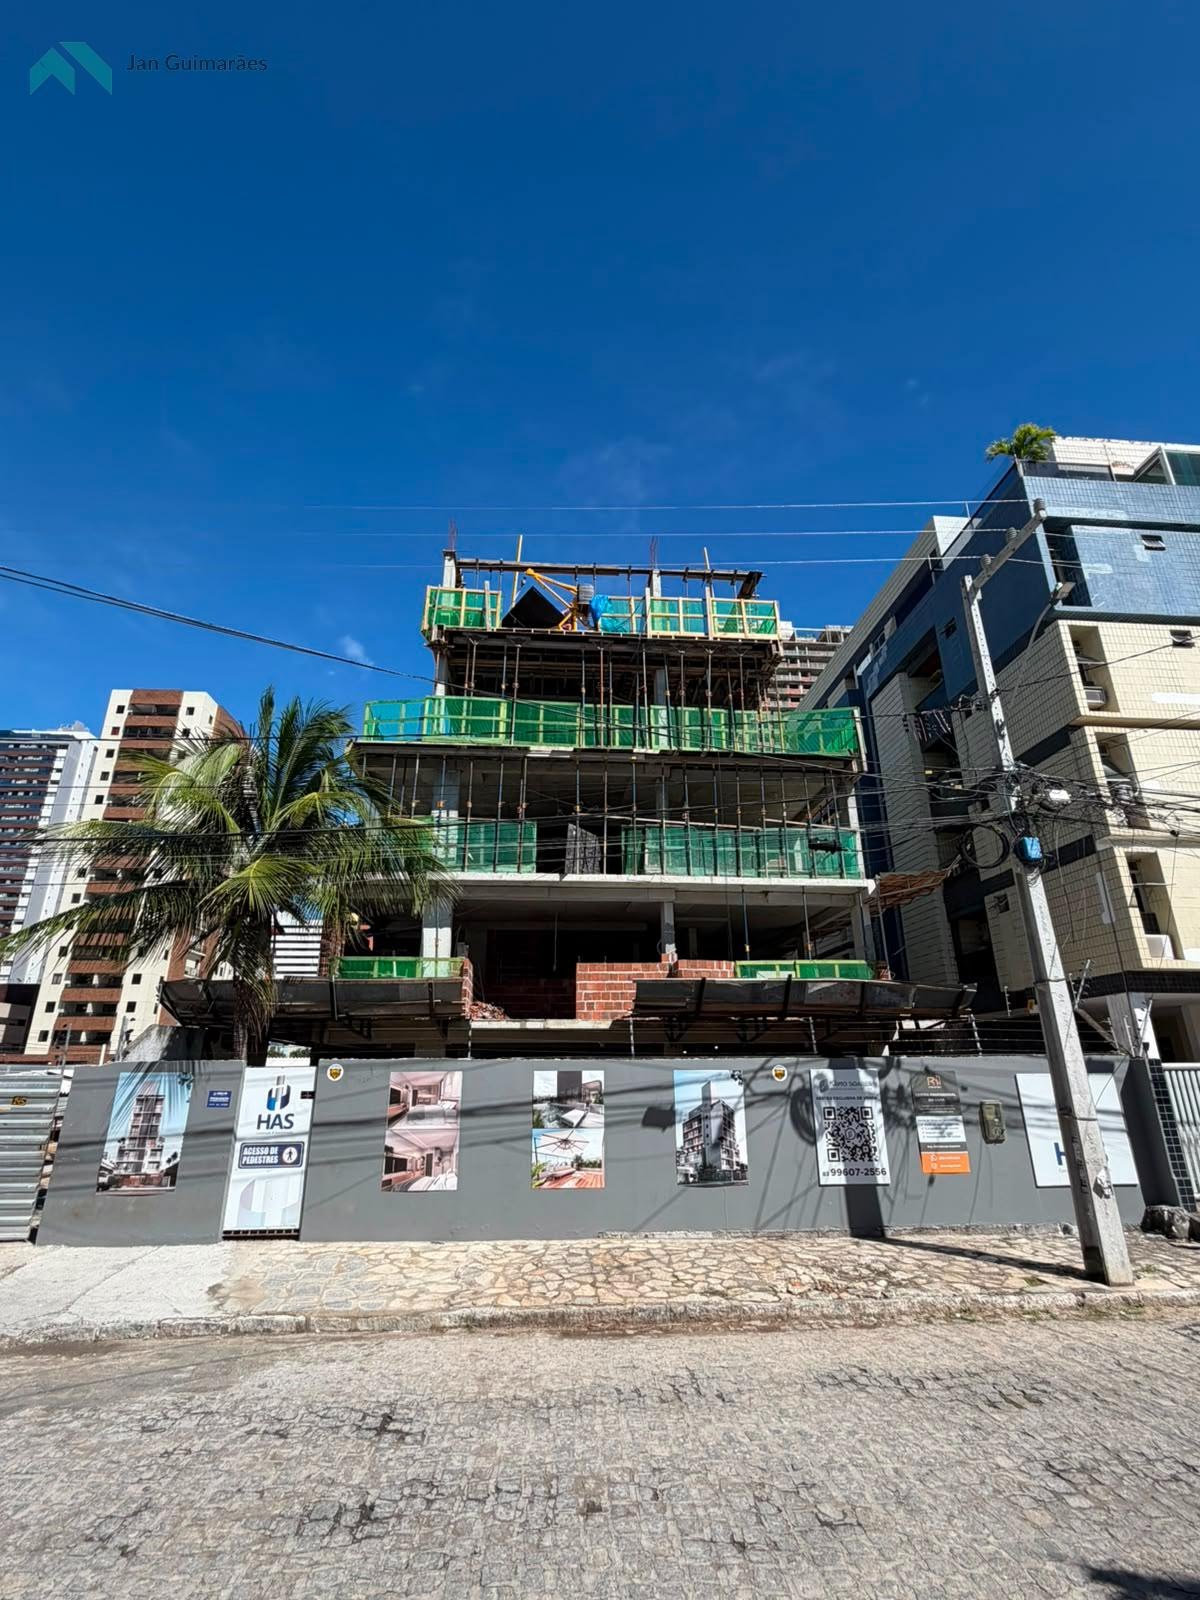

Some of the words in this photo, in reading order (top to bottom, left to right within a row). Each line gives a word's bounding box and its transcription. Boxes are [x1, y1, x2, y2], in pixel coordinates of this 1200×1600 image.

[256, 1113, 295, 1130] HAS
[243, 1146, 269, 1155] ACESSO
[269, 1146, 279, 1154] DE
[241, 1155, 279, 1165] PEDESTRES
[830, 1167, 887, 1177] 99607-2556
